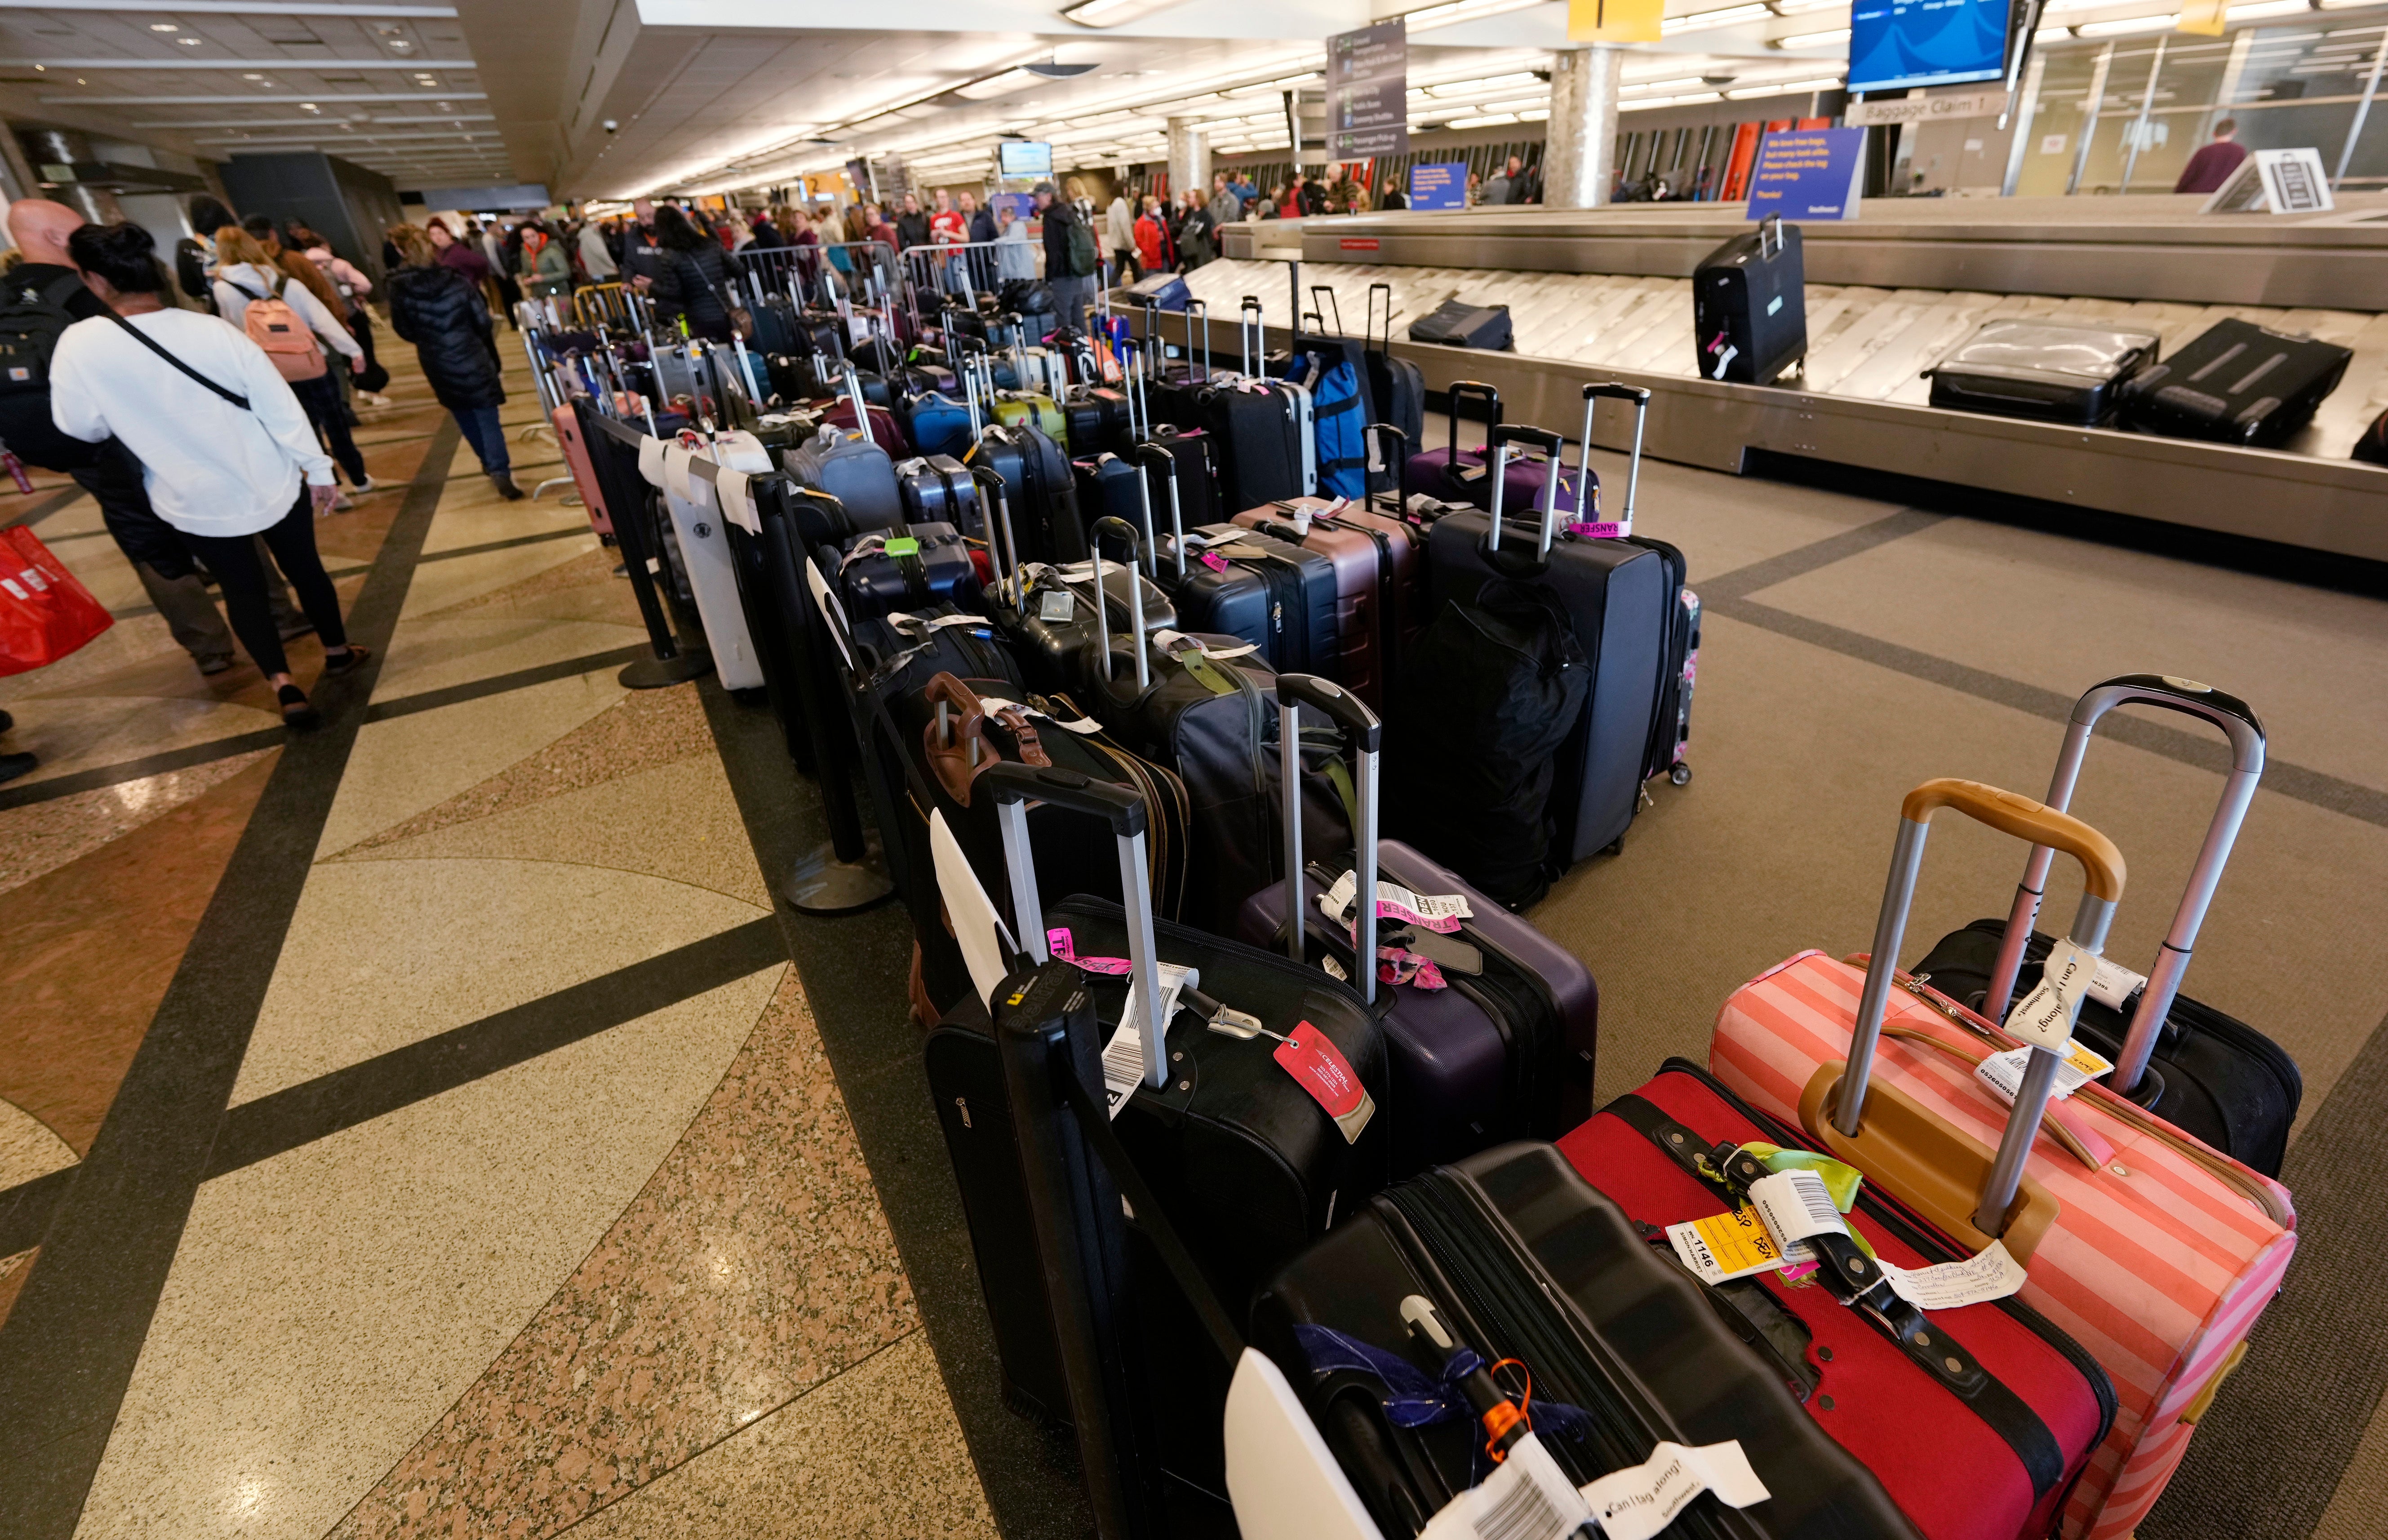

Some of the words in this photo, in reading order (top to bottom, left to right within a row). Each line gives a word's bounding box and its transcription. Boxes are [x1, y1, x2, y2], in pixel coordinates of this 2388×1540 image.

[1867, 103, 1928, 119] Baggage
[1931, 98, 1971, 113] Claim
[1979, 97, 1984, 110] 1
[1816, 160, 1828, 169] tag
[810, 178, 819, 192] 2
[1757, 190, 1782, 199] Thanks!
[1381, 902, 1452, 929] TRANSFER
[1418, 897, 1430, 914] DEN
[1430, 900, 1438, 911] 1680
[1440, 902, 1450, 913] HOU
[2062, 963, 2077, 980] Can
[2020, 986, 2050, 1016] Southwest
[2037, 1004, 2063, 1032] along?
[1308, 1065, 1339, 1097] www.celestialtravel.net
[1319, 1065, 1338, 1085] 303-773-1224
[1321, 1053, 1349, 1085] CELESTIAL
[1328, 1067, 1339, 1078] Travel
[1341, 1081, 1350, 1093] Tours
[1980, 1068, 2017, 1099] 0526050561
[1749, 1208, 1762, 1226] RE-ROUTE
[1762, 1199, 1788, 1242] 0526050560
[1679, 1231, 1703, 1274] SIMON/HARRIET
[1688, 1230, 1695, 1239] WN
[1693, 1238, 1714, 1268] 1146
[1753, 1237, 1774, 1259] DEN
[1609, 1500, 1630, 1513] Can
[1629, 1495, 1636, 1506] I
[1635, 1492, 1654, 1505] tag
[1654, 1459, 1682, 1495] along?
